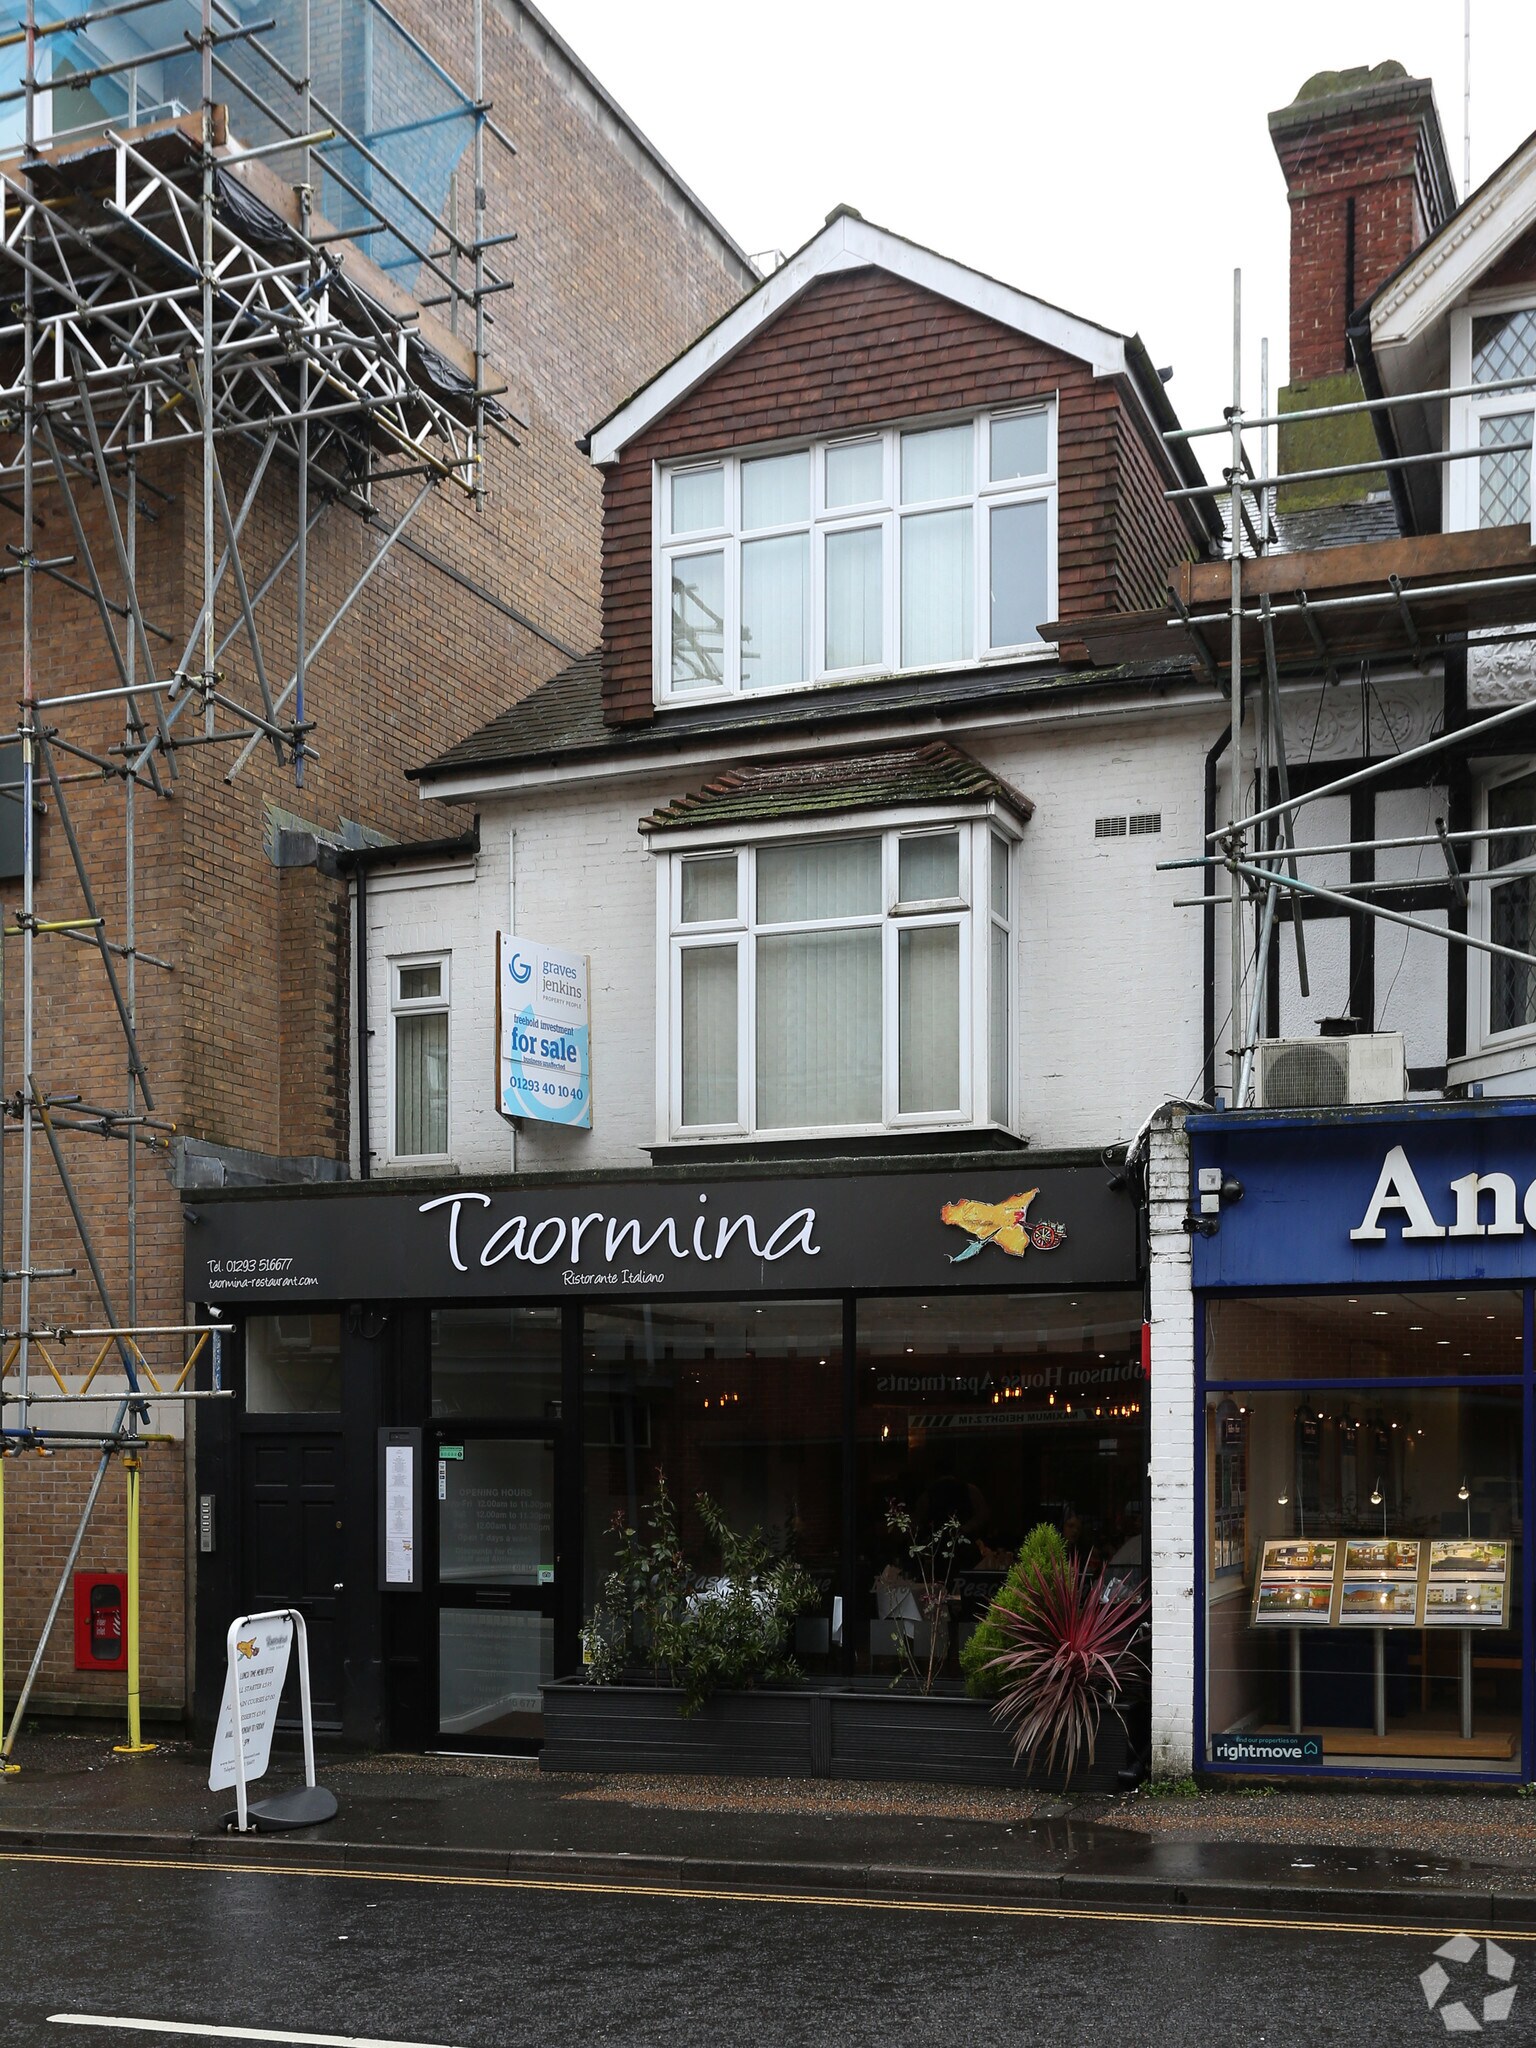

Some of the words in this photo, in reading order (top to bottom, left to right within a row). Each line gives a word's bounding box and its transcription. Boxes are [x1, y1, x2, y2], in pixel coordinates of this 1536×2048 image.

[543, 961, 576, 979] graves
[543, 976, 582, 998] jenkins
[543, 995, 564, 1005] PROPERTY
[566, 1000, 582, 1009] PEOPLE
[514, 1014, 539, 1028] freehold
[540, 1020, 574, 1036] investment
[512, 1027, 537, 1054] for
[541, 1038, 576, 1063] sale
[523, 1056, 542, 1066] business
[543, 1060, 565, 1070] unaffected
[510, 1076, 540, 1092] 01293
[542, 1083, 555, 1095] 40
[1350, 1145, 1536, 1240] An
[418, 1192, 821, 1272] Taormina
[207, 1260, 224, 1272] Tel.
[226, 1259, 256, 1272] 01293
[259, 1258, 292, 1272] 516677
[208, 1276, 318, 1288] taormina-restaurant.com
[562, 1270, 618, 1285] Ristorante
[622, 1269, 664, 1284] Italiano
[459, 1488, 498, 1497] OPENING
[501, 1488, 533, 1497] HOURS
[1217, 1743, 1302, 1760] rightmove
